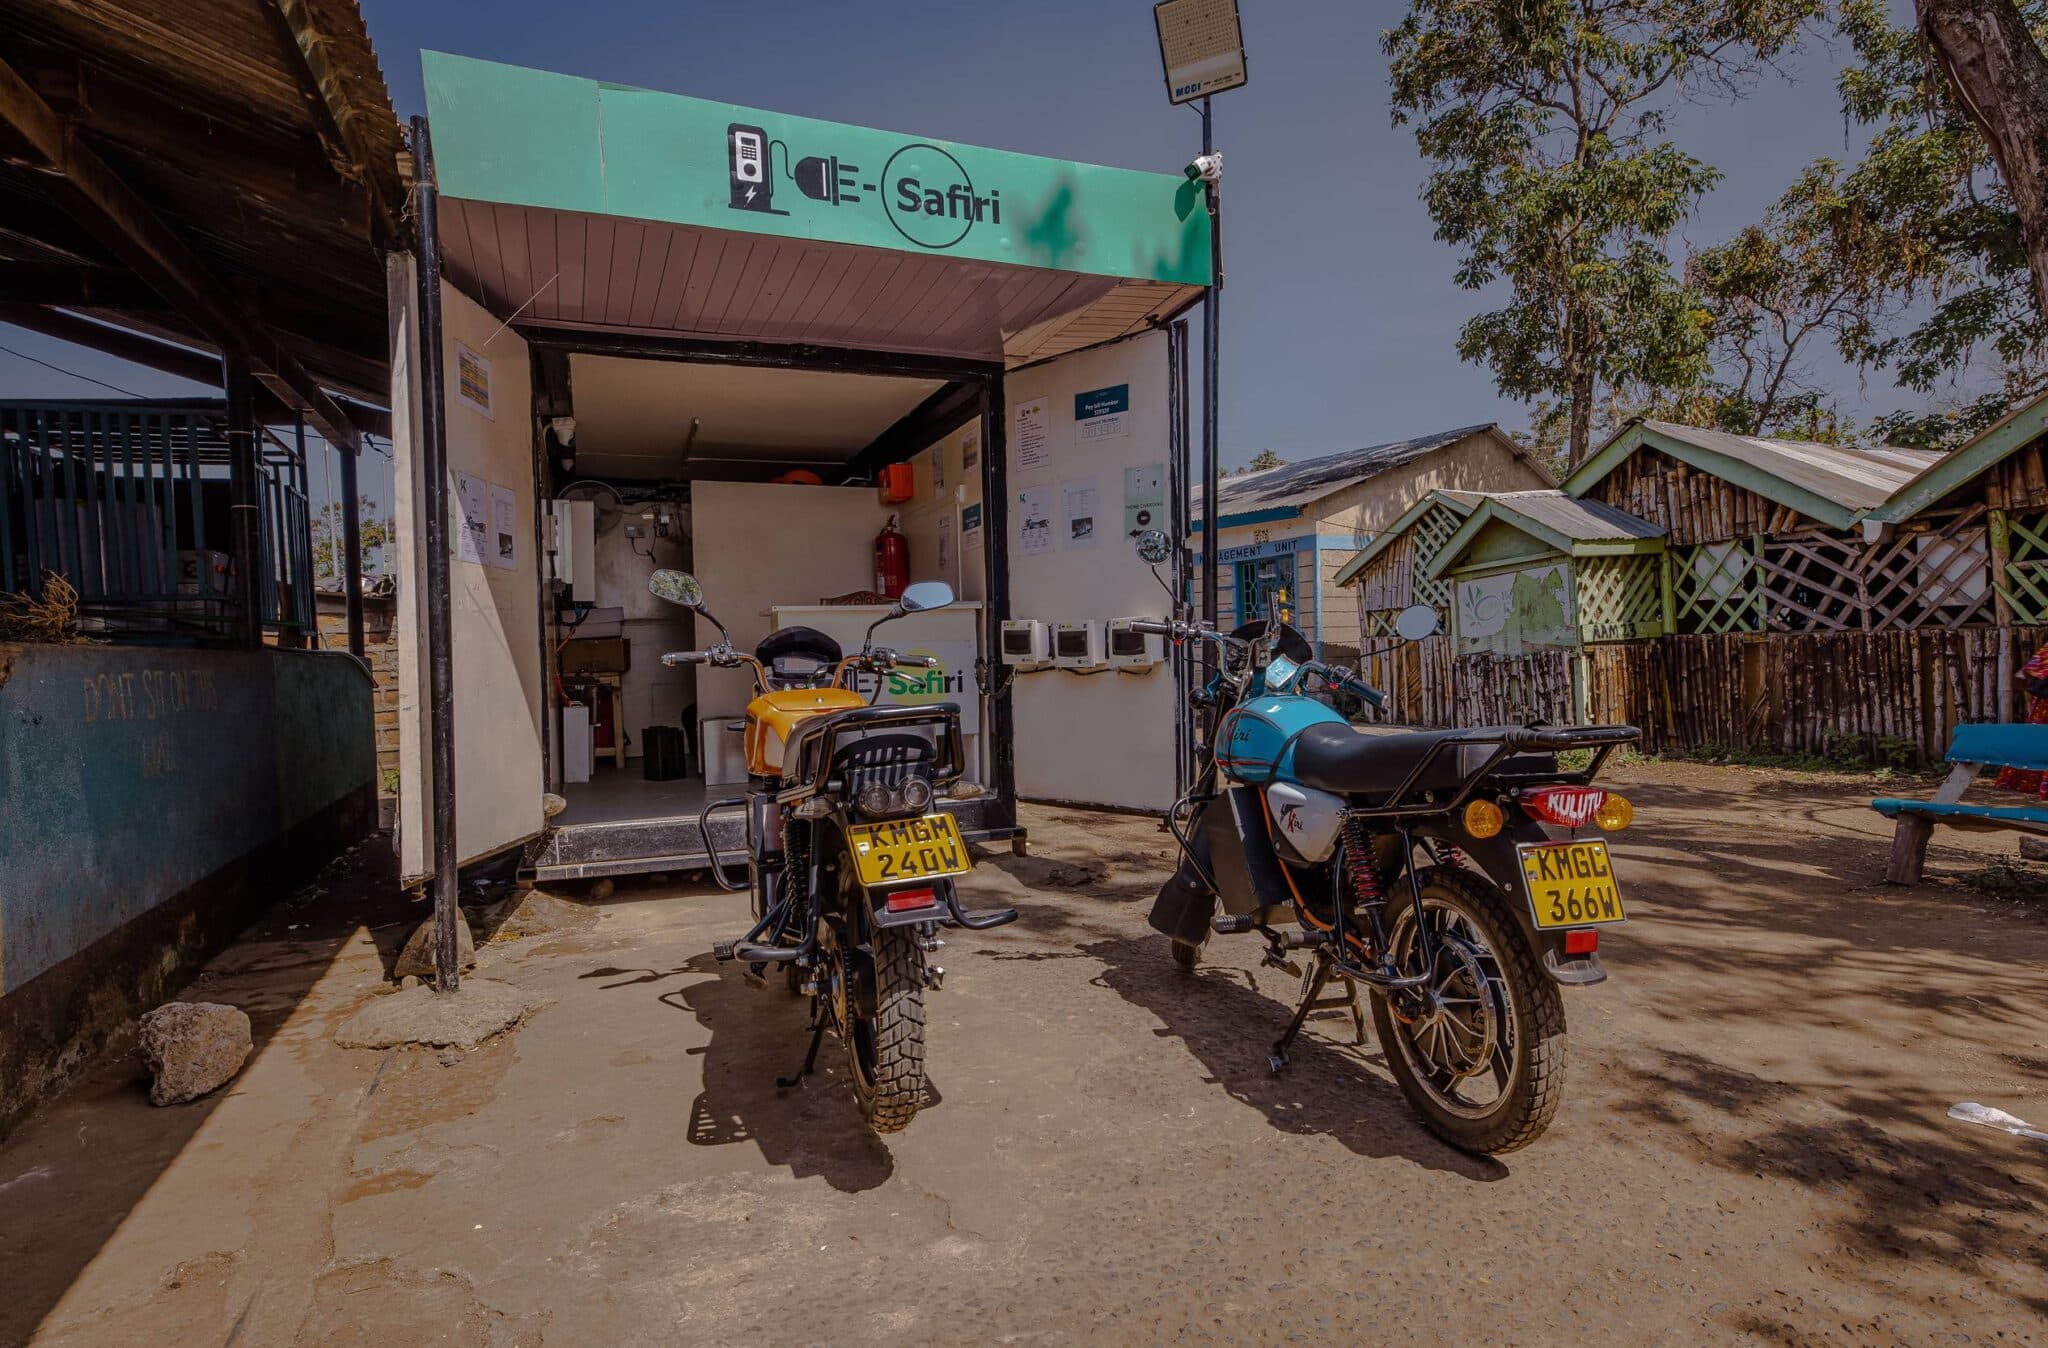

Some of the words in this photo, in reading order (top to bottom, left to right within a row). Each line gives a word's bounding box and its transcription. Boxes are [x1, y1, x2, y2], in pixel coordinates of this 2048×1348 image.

[1175, 83, 1201, 97] MODI
[897, 177, 1000, 225] Safiri
[1274, 540, 1298, 553] UNIT
[888, 670, 964, 696] Safiri
[868, 815, 953, 850] KMGM
[877, 844, 960, 878] 240W
[1537, 847, 1608, 881] KMGL
[1546, 885, 1616, 922] 366W
